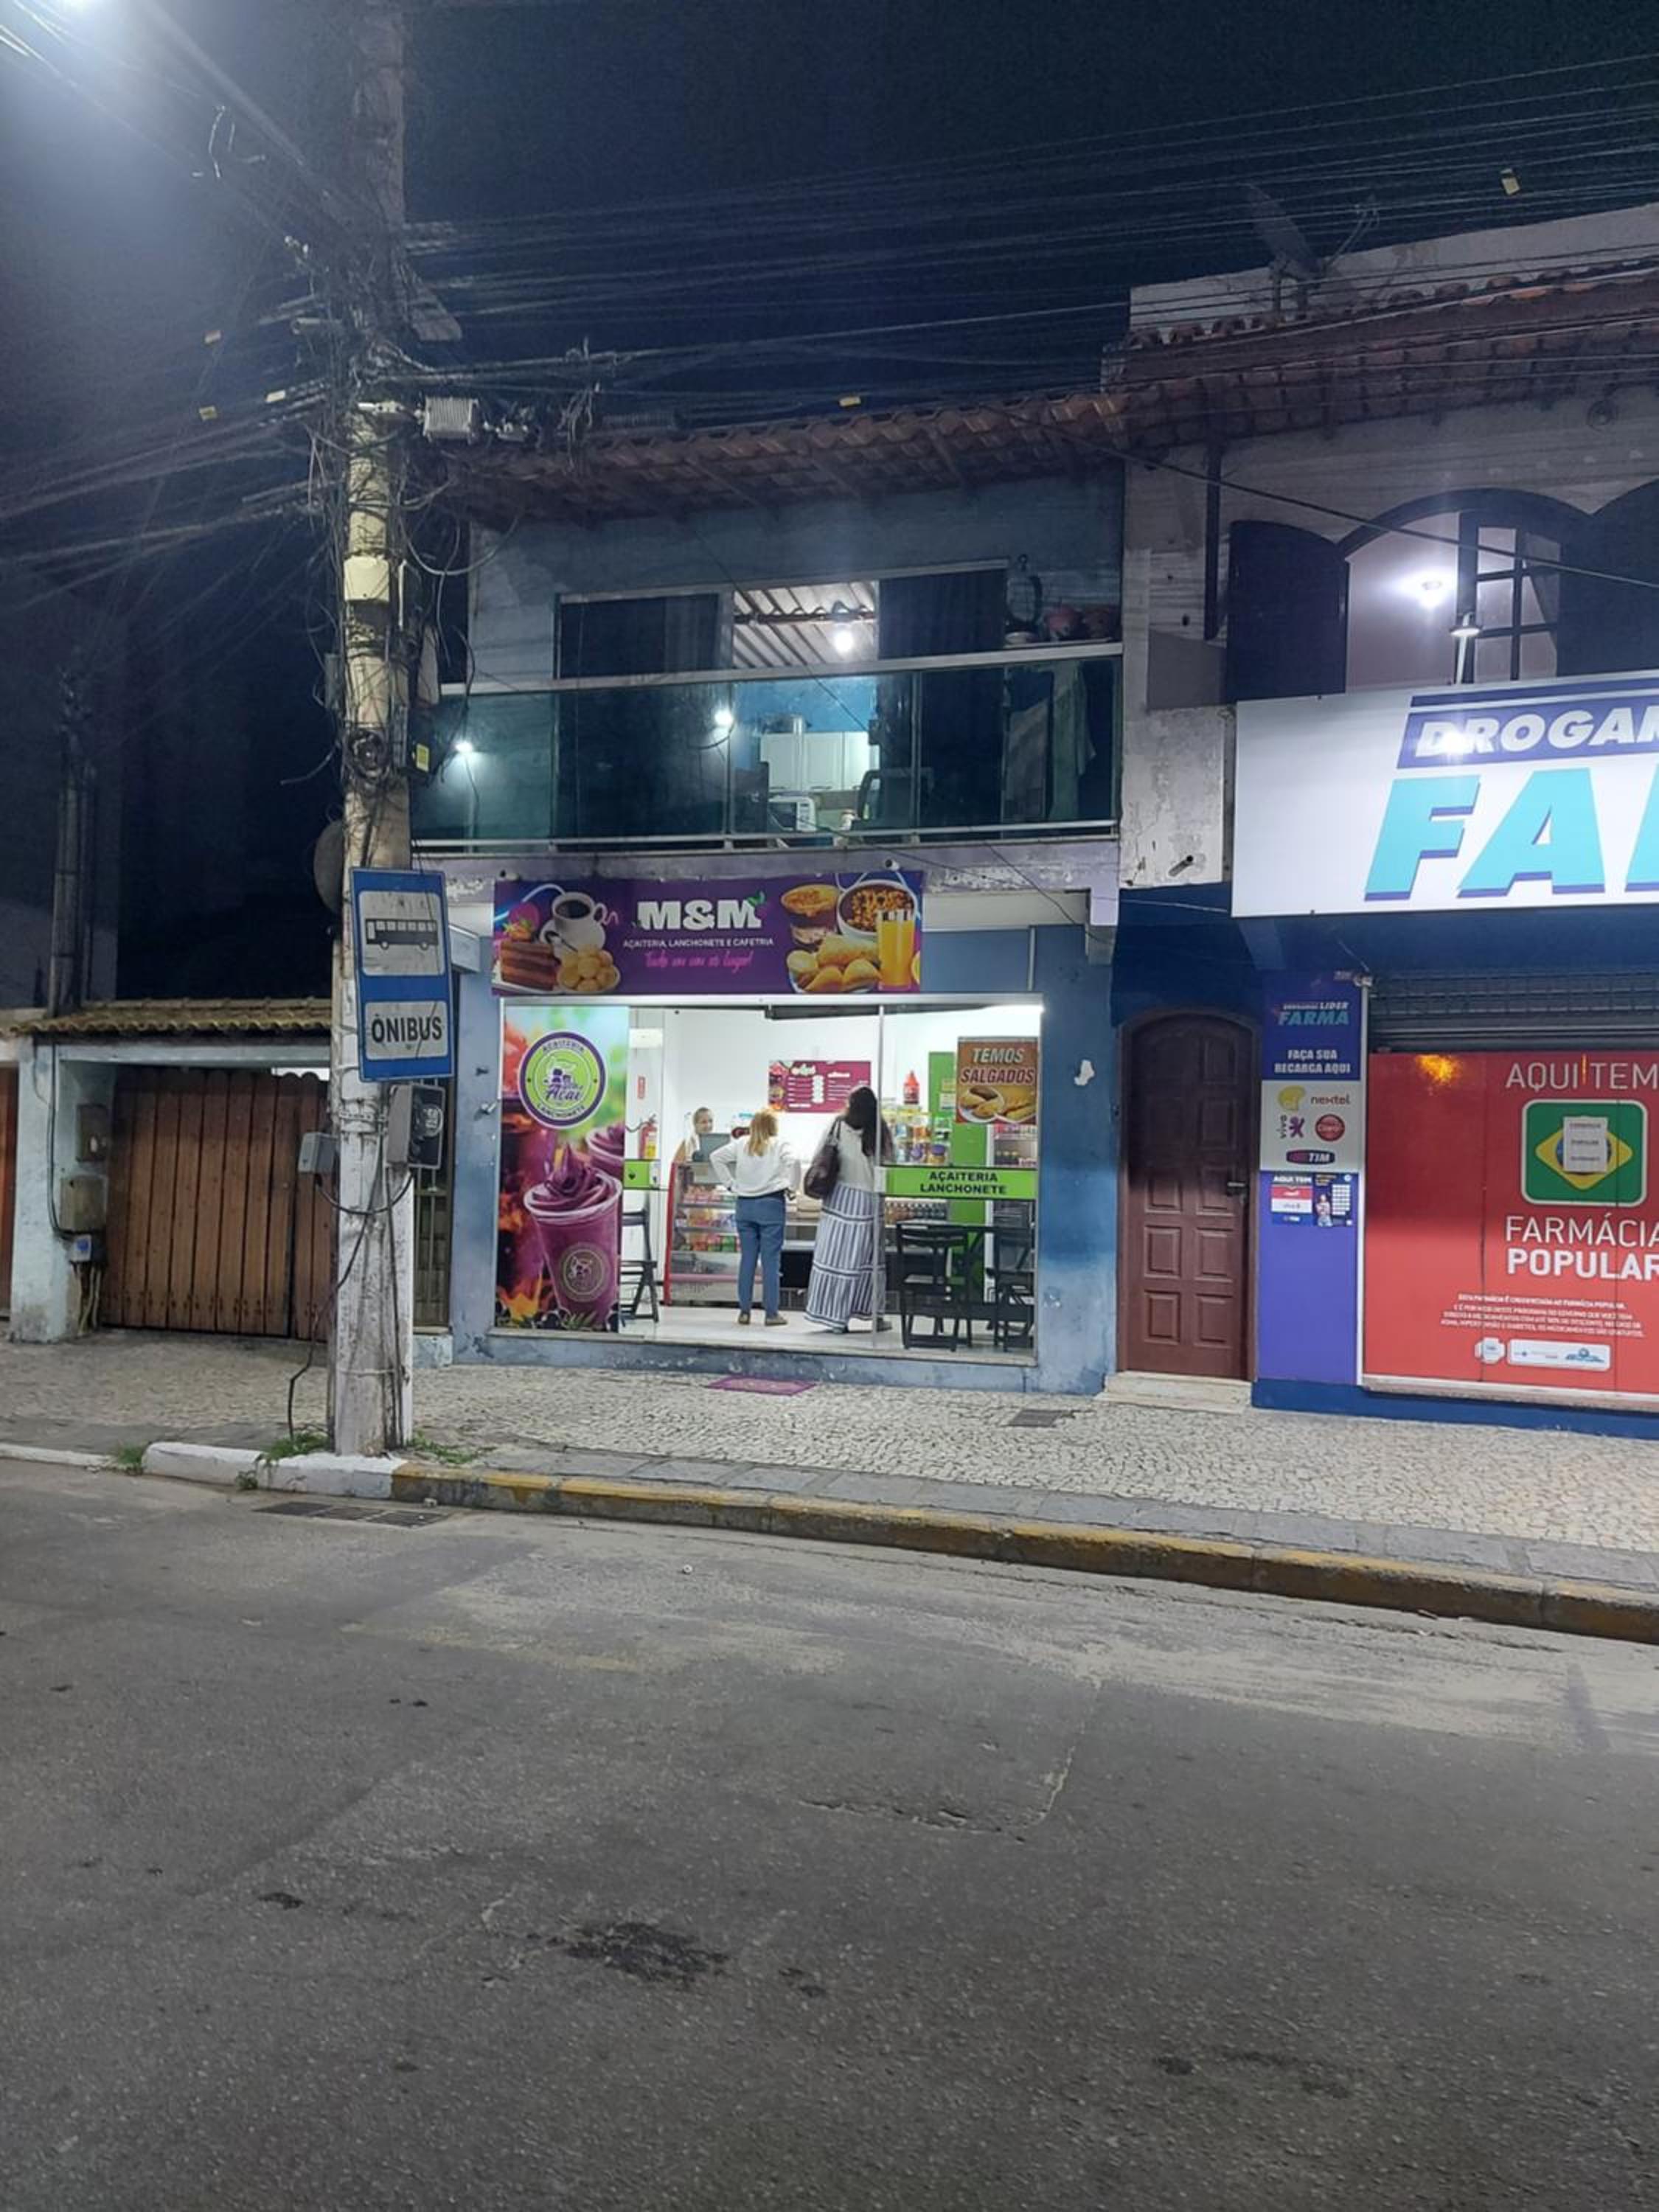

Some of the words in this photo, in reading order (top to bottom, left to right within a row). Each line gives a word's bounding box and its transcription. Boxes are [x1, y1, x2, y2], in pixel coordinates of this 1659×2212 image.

[1363, 765, 1659, 901] FA
[637, 899, 762, 931] M&M
[669, 938, 725, 947] LANCHONETE
[726, 938, 731, 946] E
[1279, 1011, 1349, 1026] FARMA
[372, 1013, 442, 1043] ÔNIBUS
[973, 1048, 1026, 1063] TEMOS
[1287, 1049, 1314, 1061] FAÇA
[1316, 1049, 1338, 1059] SUA
[1274, 1062, 1323, 1074] RECARGA
[1324, 1062, 1351, 1074] AQUI
[961, 1068, 1034, 1084] SALGADOS
[1505, 1062, 1579, 1093] AQUI
[1589, 1062, 1658, 1090] TEM
[1311, 1093, 1350, 1105] nextel
[1309, 1152, 1330, 1163] TIM
[929, 1172, 998, 1183] AÇAITERIA
[920, 1183, 1006, 1194] LANCHONETE
[1506, 1212, 1659, 1248] FARMÁCIA
[1507, 1248, 1659, 1281] POPULAR
